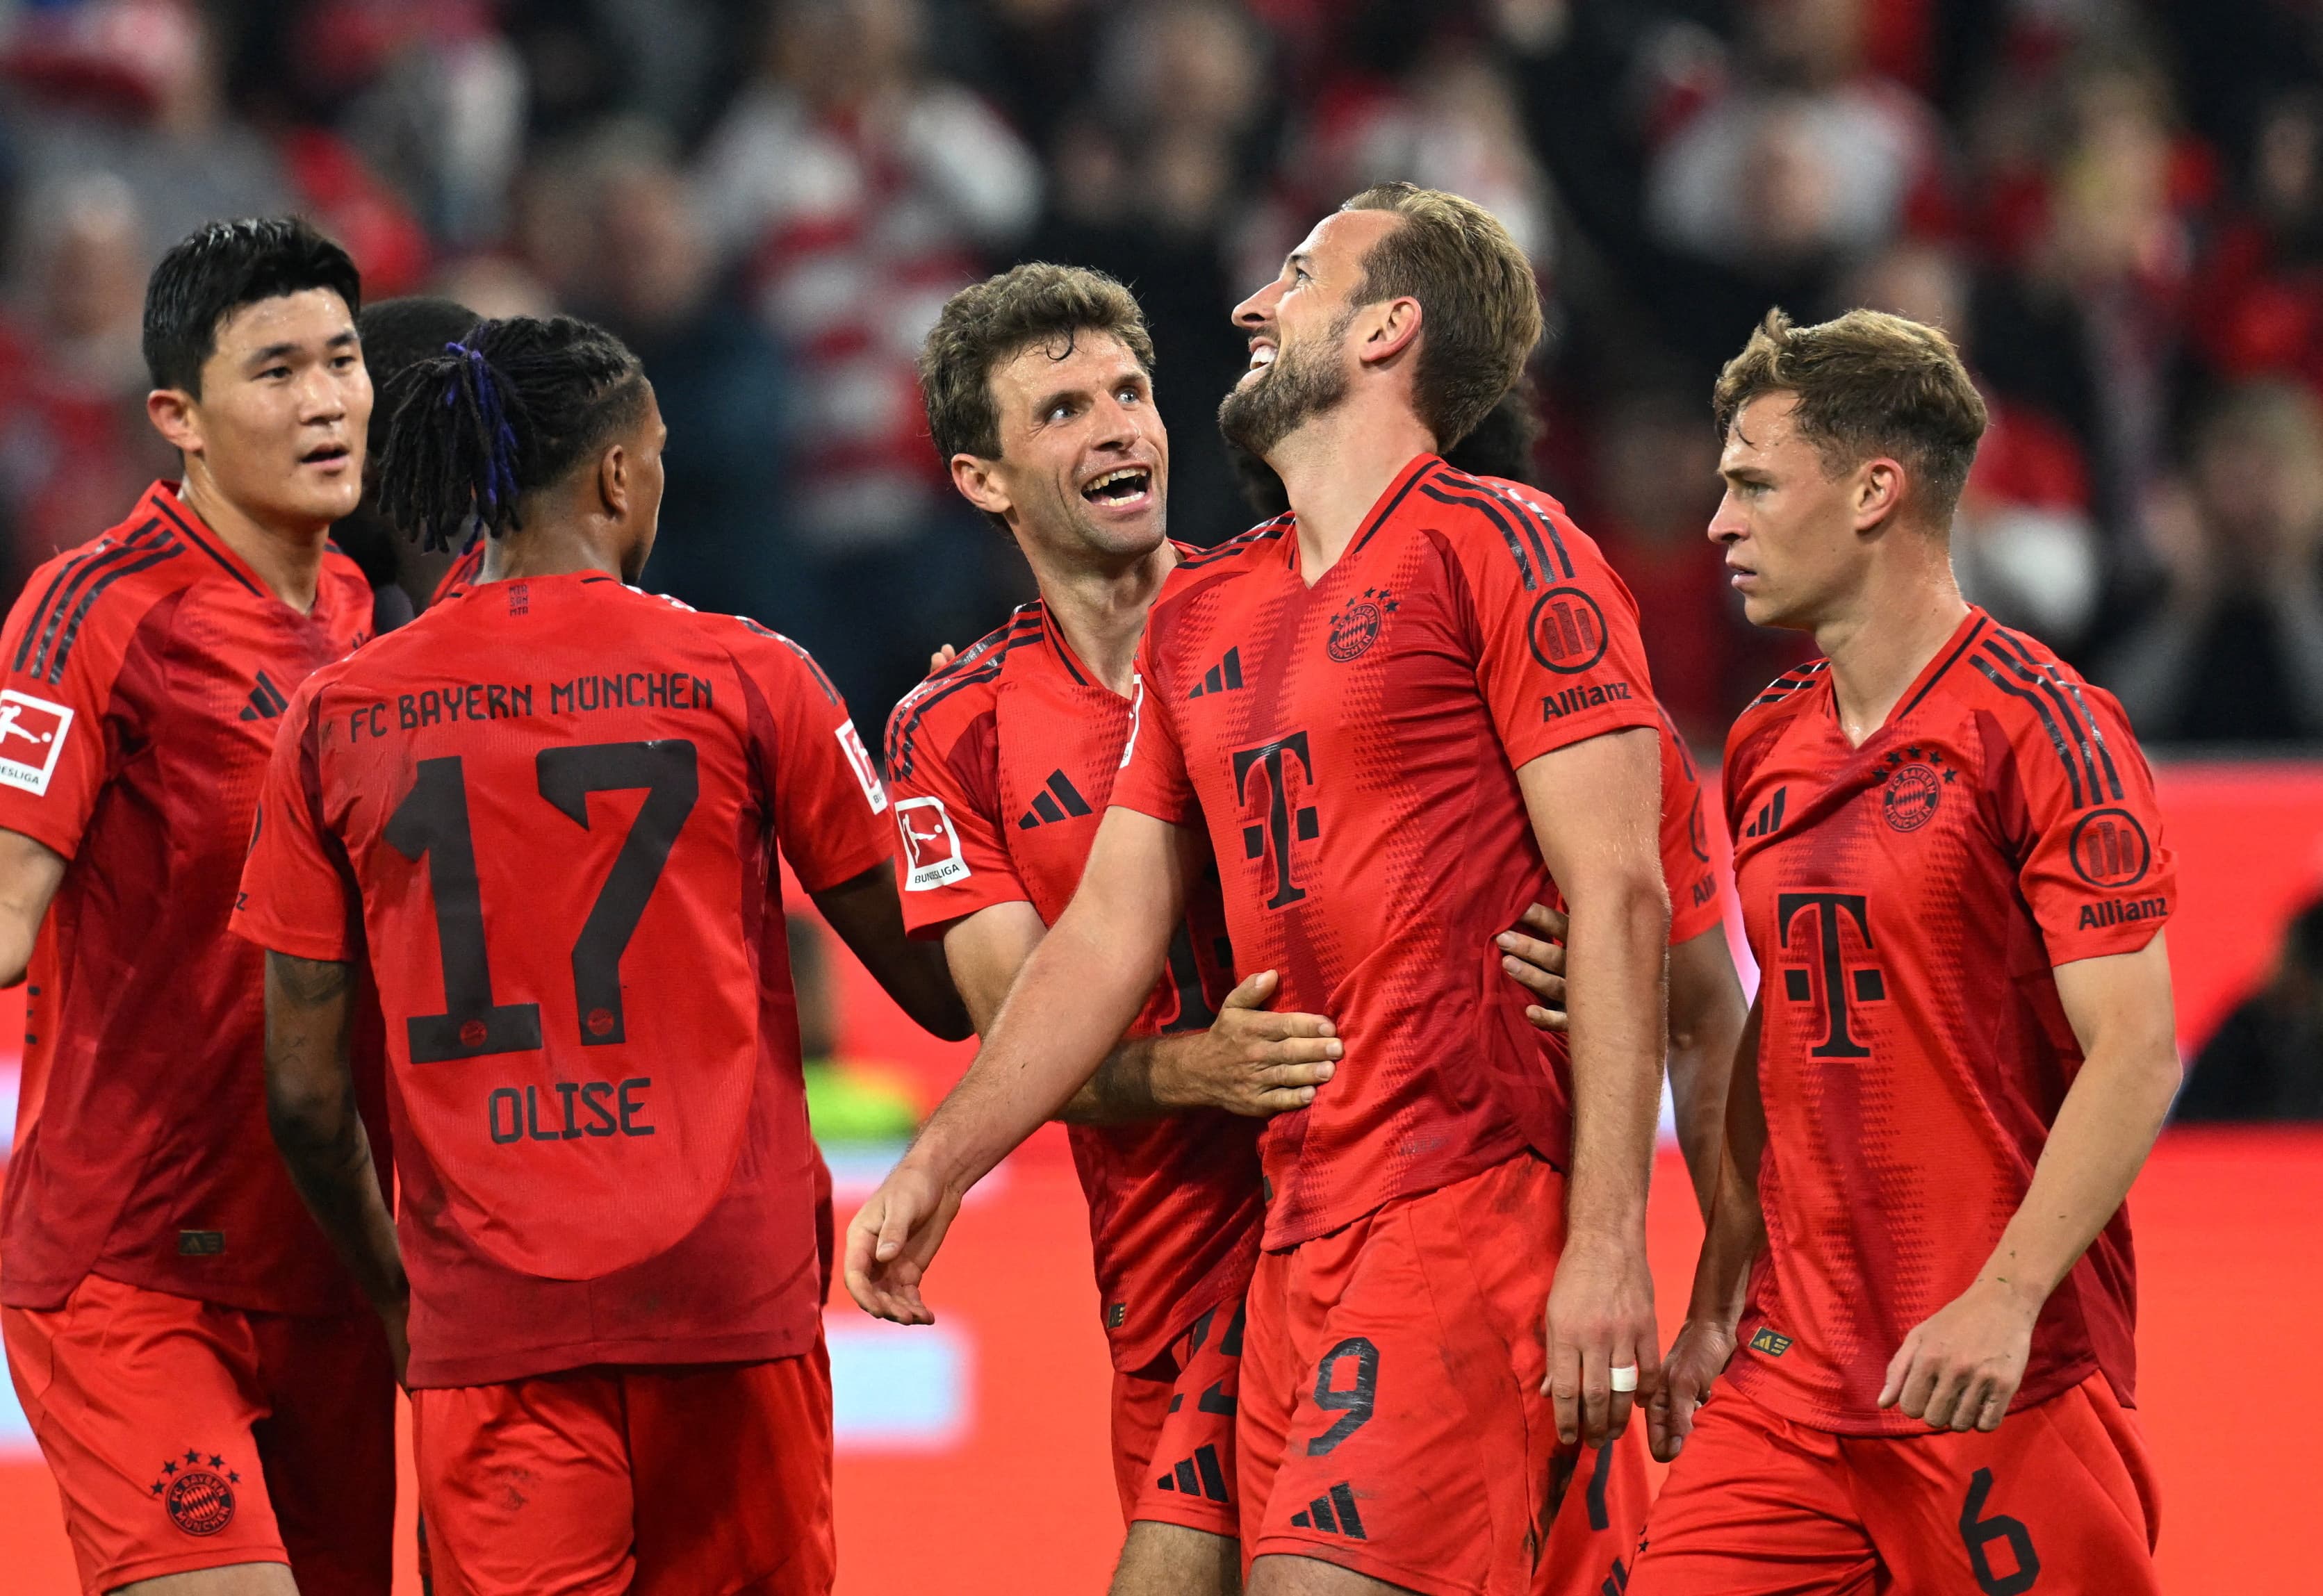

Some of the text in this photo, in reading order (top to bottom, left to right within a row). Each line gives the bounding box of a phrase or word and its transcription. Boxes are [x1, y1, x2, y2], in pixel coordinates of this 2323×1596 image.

[350, 673, 713, 743] FC BAYERN MÜNCHEN
[1541, 682, 1632, 723] Allianz
[382, 739, 699, 1064] 17
[2079, 898, 2168, 930] Allianz
[489, 1078, 655, 1144] OLISE
[1306, 1337, 1380, 1456] 9
[1959, 1467, 2041, 1596] 6
